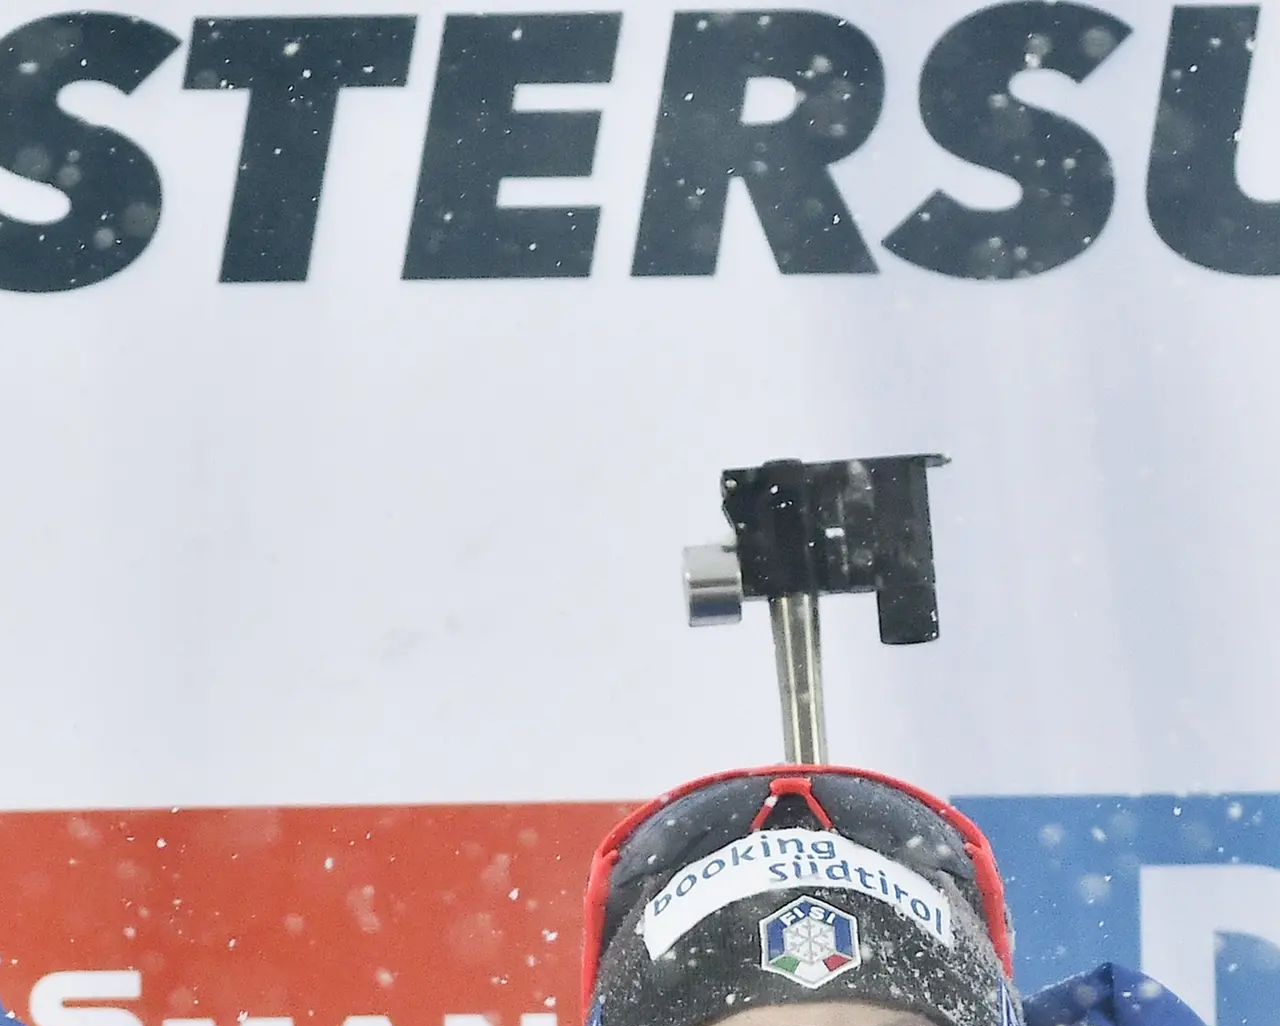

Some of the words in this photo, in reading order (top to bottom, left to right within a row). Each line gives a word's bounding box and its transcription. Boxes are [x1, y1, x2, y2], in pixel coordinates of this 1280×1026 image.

[653, 834, 836, 916] booking
[768, 855, 943, 935] südtirol
[780, 906, 836, 926] FISI
